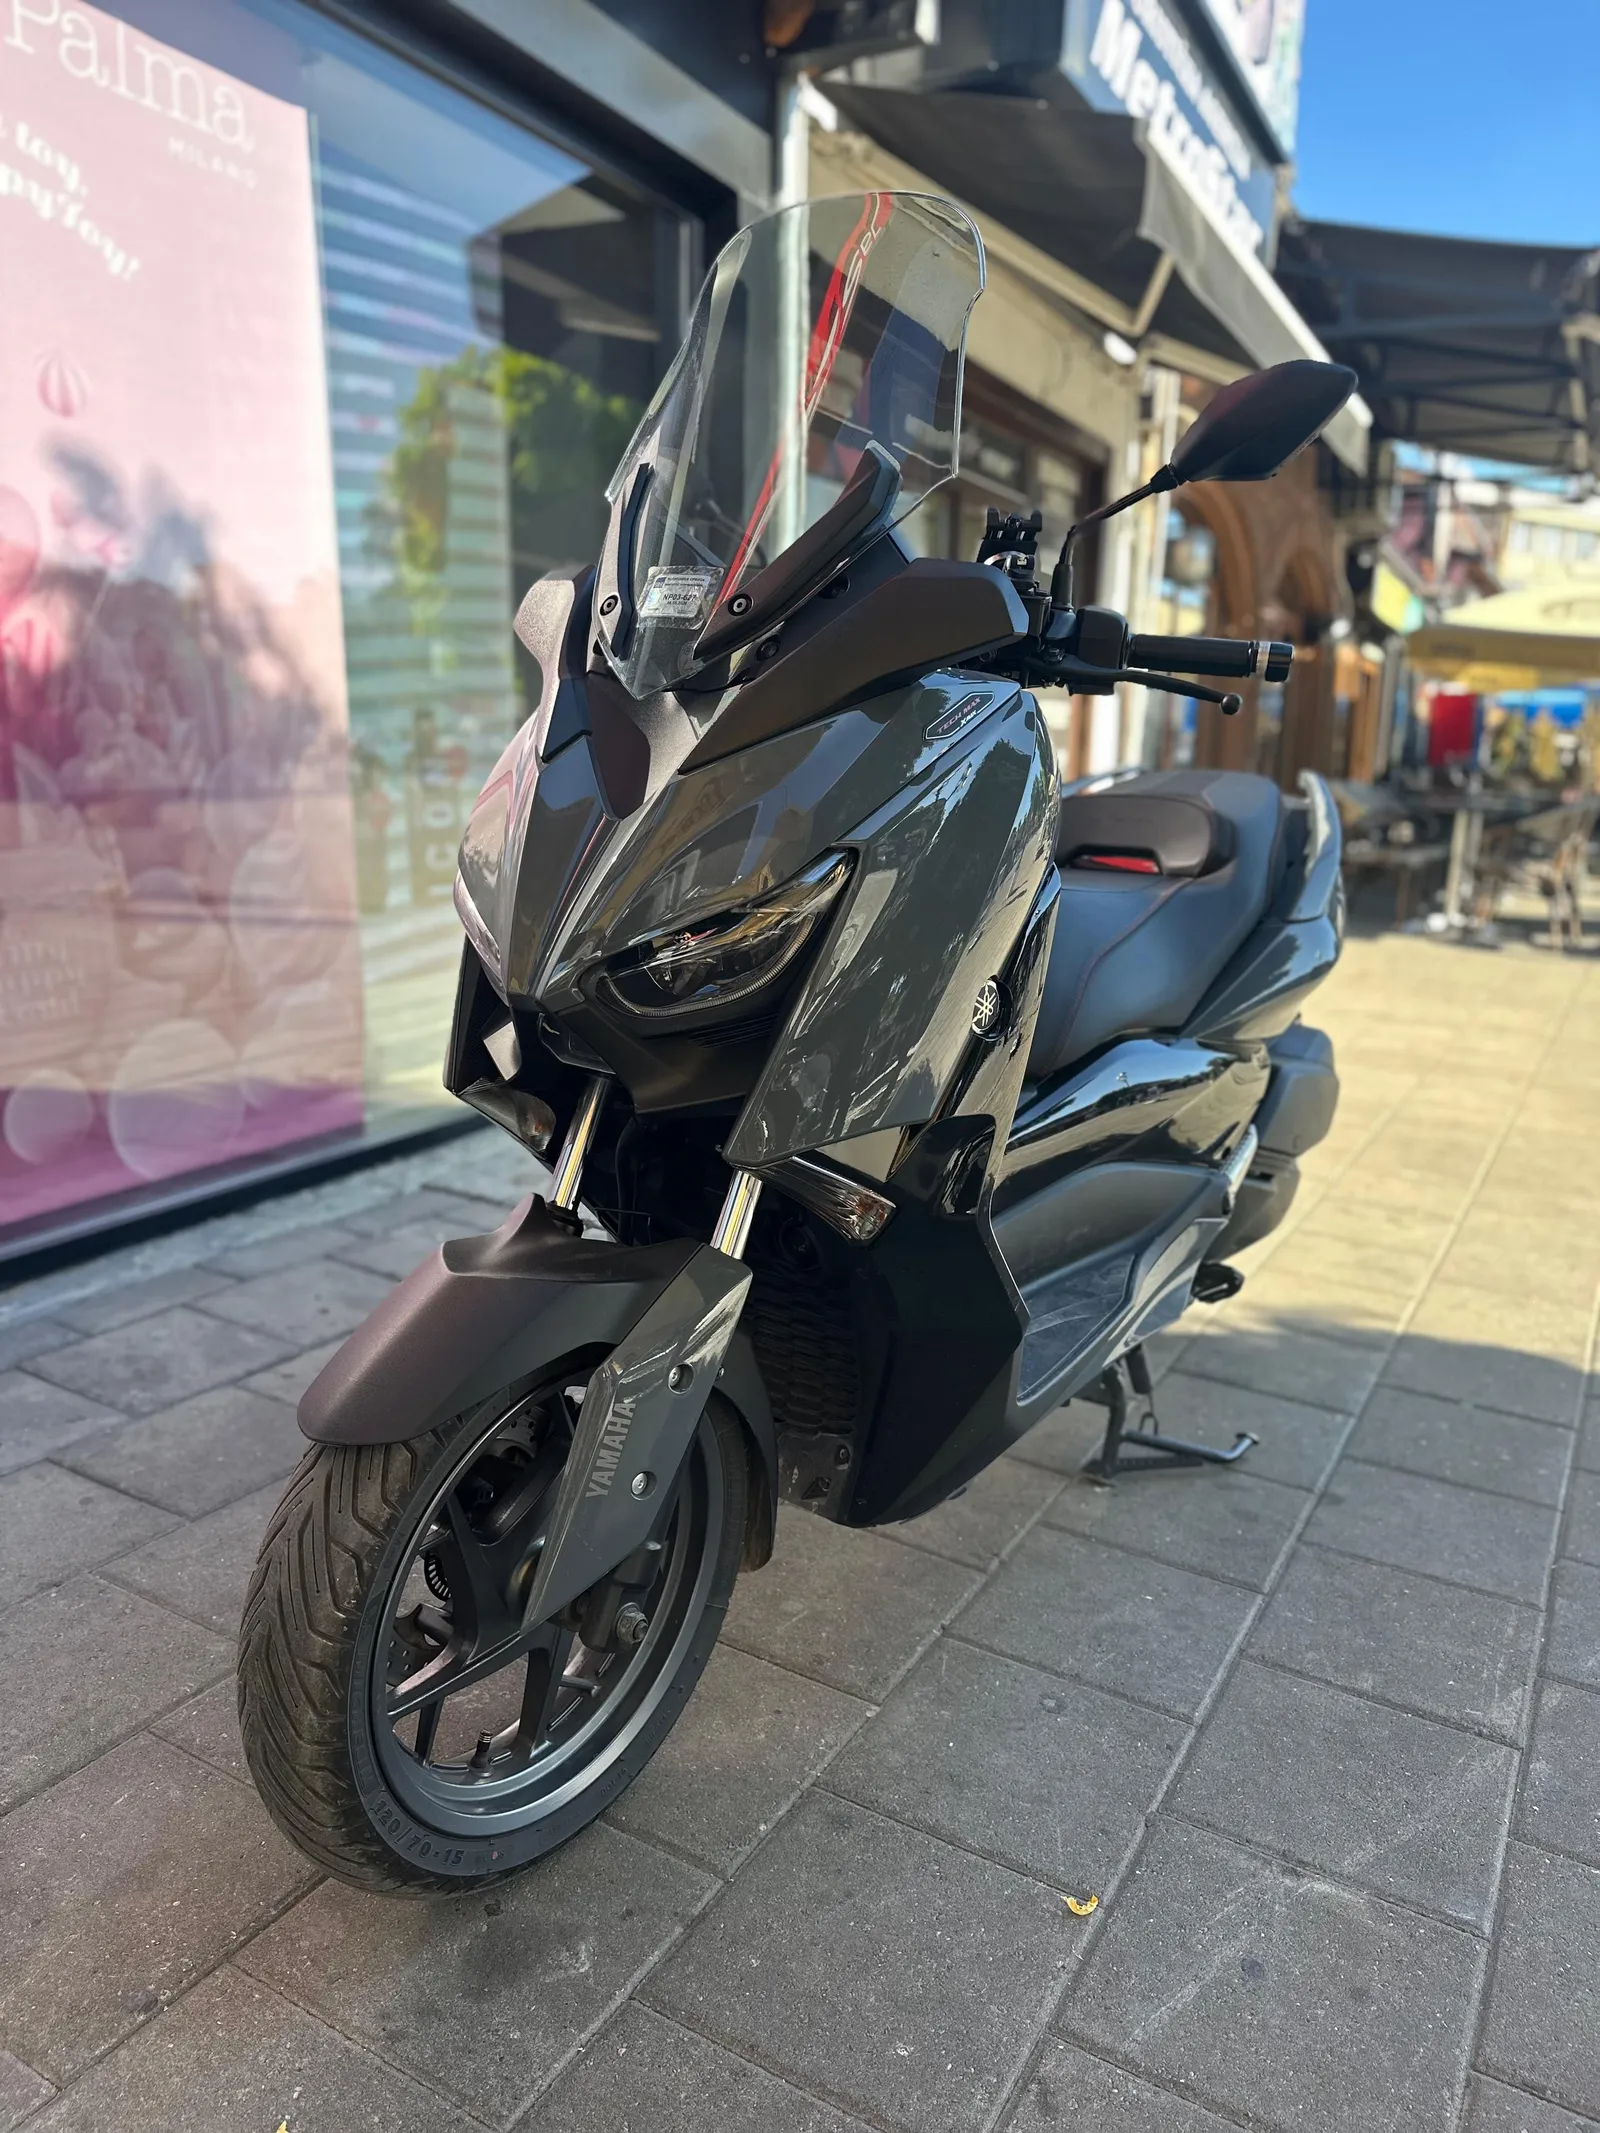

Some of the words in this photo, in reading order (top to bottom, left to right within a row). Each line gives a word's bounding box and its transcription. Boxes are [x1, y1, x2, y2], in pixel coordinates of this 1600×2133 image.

[3, 0, 257, 153] Palma
[937, 711, 962, 734] TECH
[963, 696, 981, 714] MAX
[585, 1402, 637, 1498] YAMAHA
